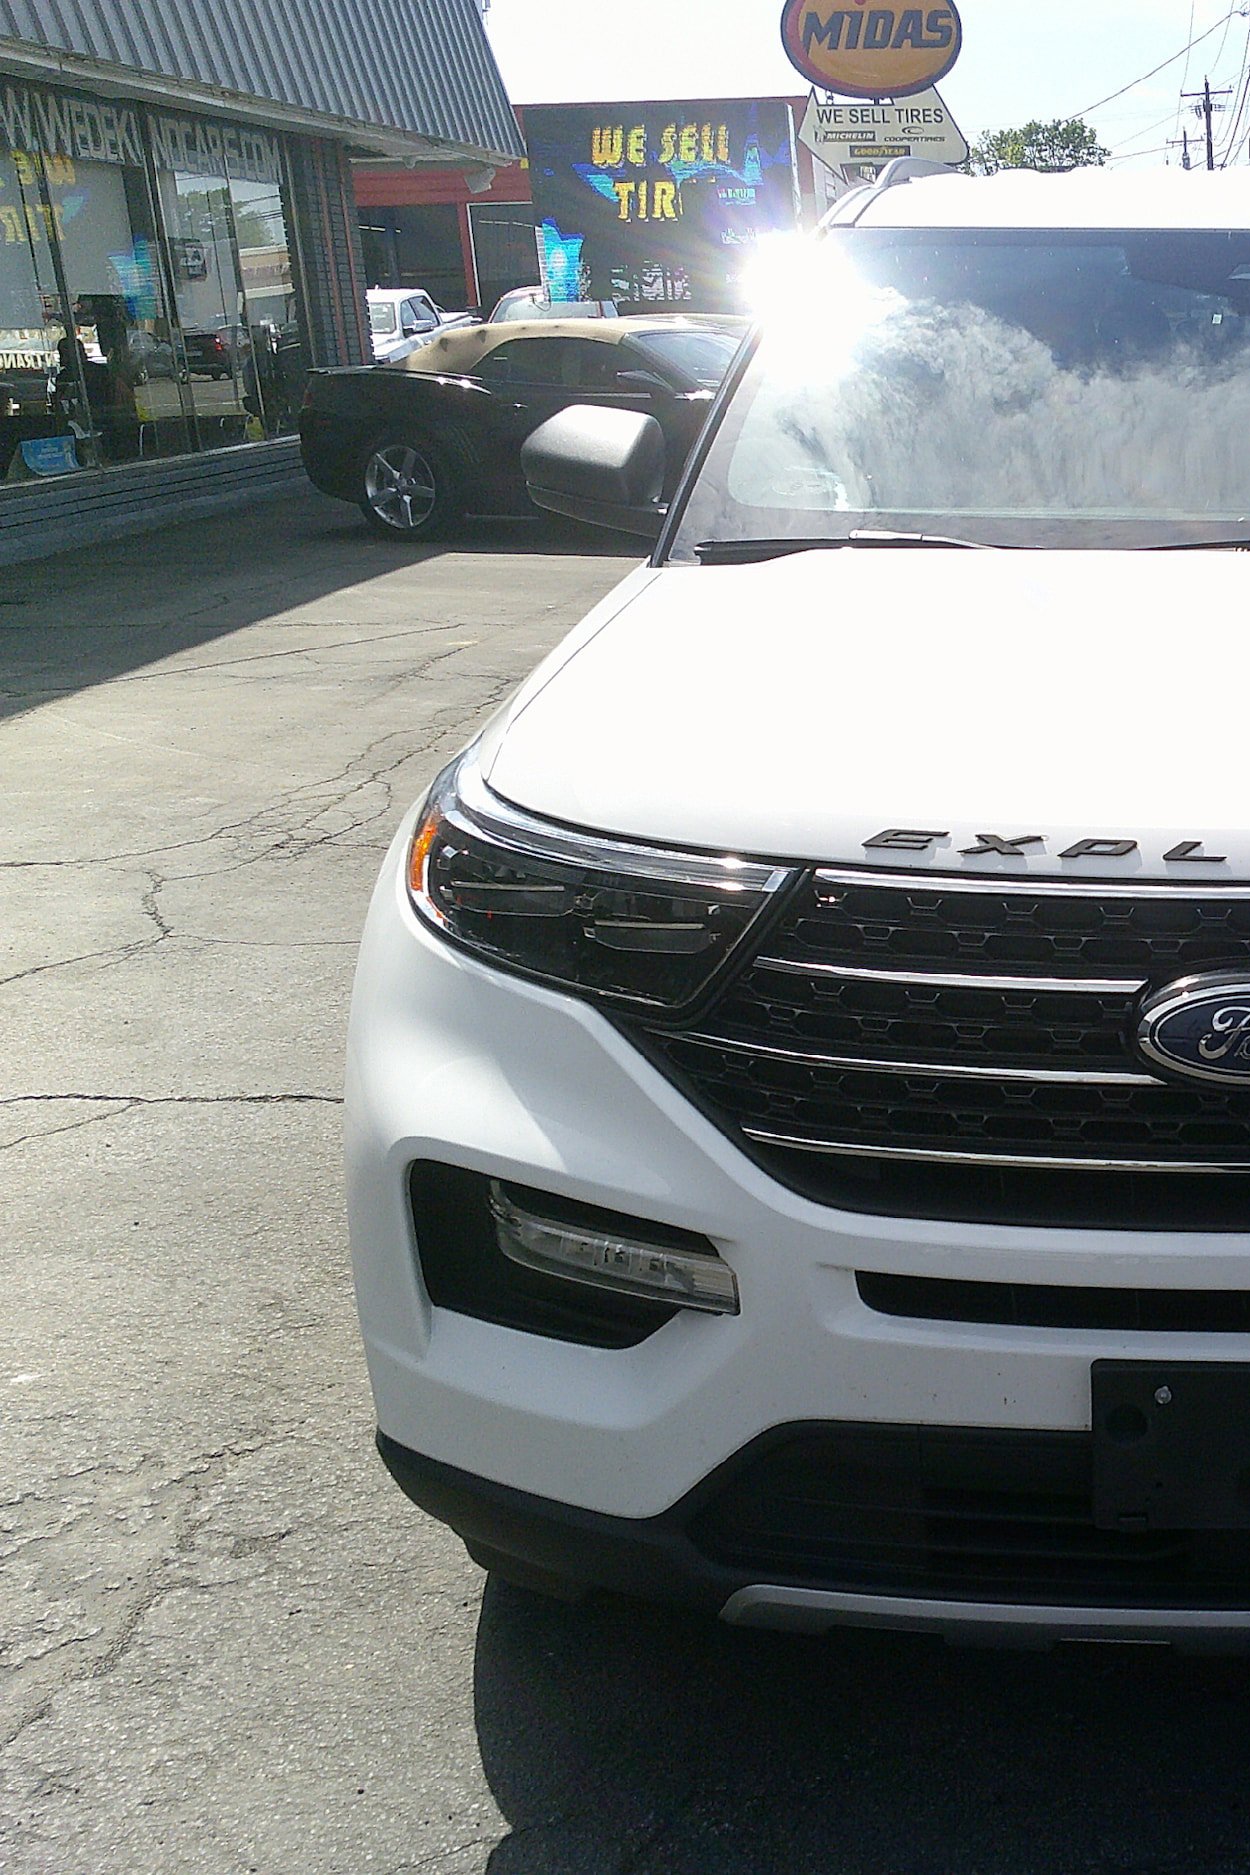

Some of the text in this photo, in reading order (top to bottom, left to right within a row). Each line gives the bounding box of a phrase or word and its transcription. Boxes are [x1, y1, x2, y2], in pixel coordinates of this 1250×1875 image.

[801, 9, 953, 56] MIDAS
[817, 108, 943, 124] WE SELL TIRES
[591, 122, 731, 168] WE SELL
[826, 131, 875, 141] MICHELIN
